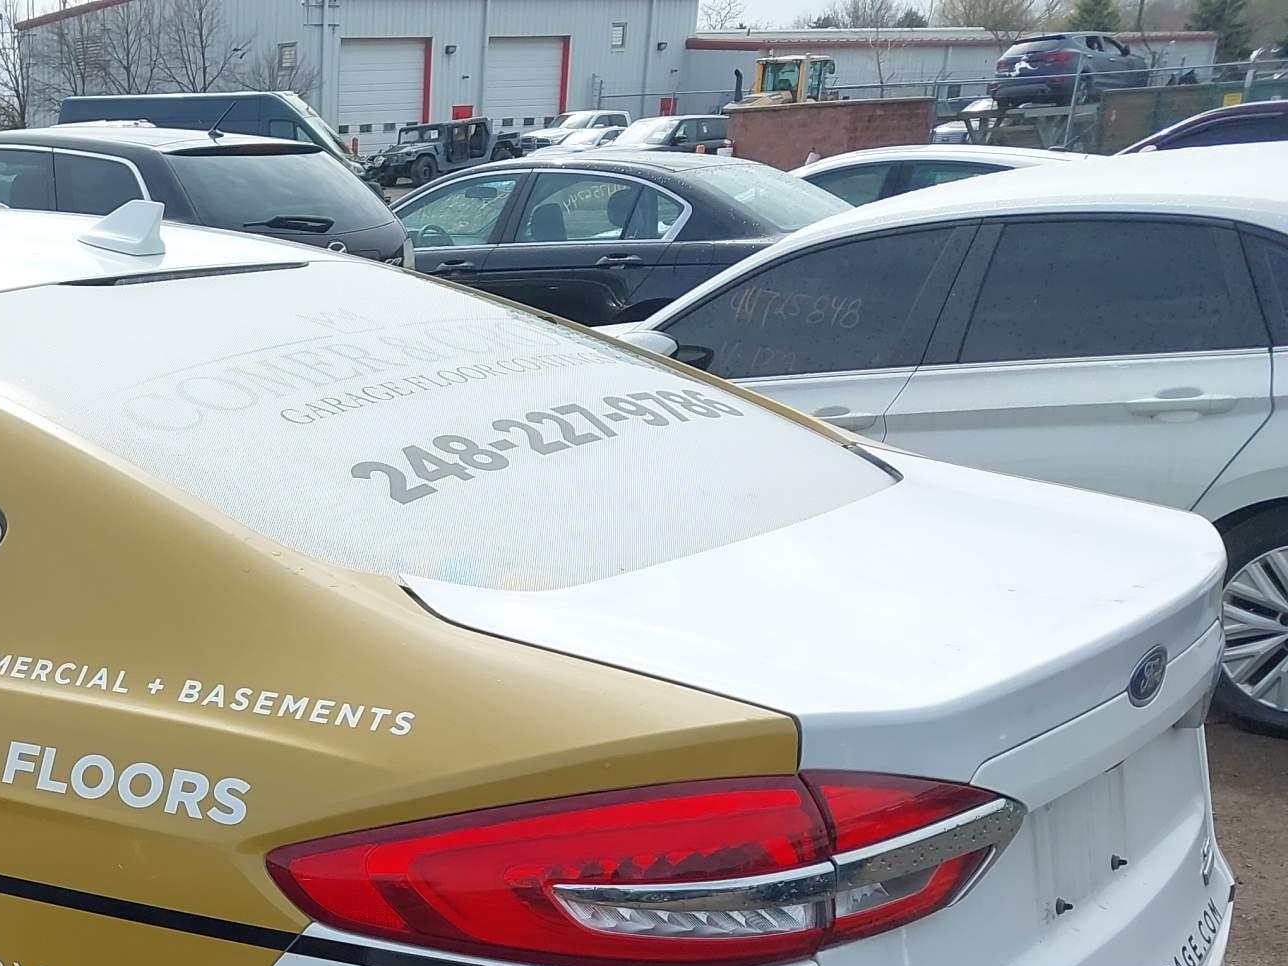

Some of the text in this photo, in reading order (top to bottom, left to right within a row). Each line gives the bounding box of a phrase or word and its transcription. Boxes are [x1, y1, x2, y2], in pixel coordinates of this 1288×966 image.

[279, 380, 414, 425] GARAGE
[404, 363, 500, 392] FLOOR
[350, 389, 744, 505] 248-227-9786
[178, 678, 416, 738] BASEMENTS
[2, 741, 251, 827] FLOORS
